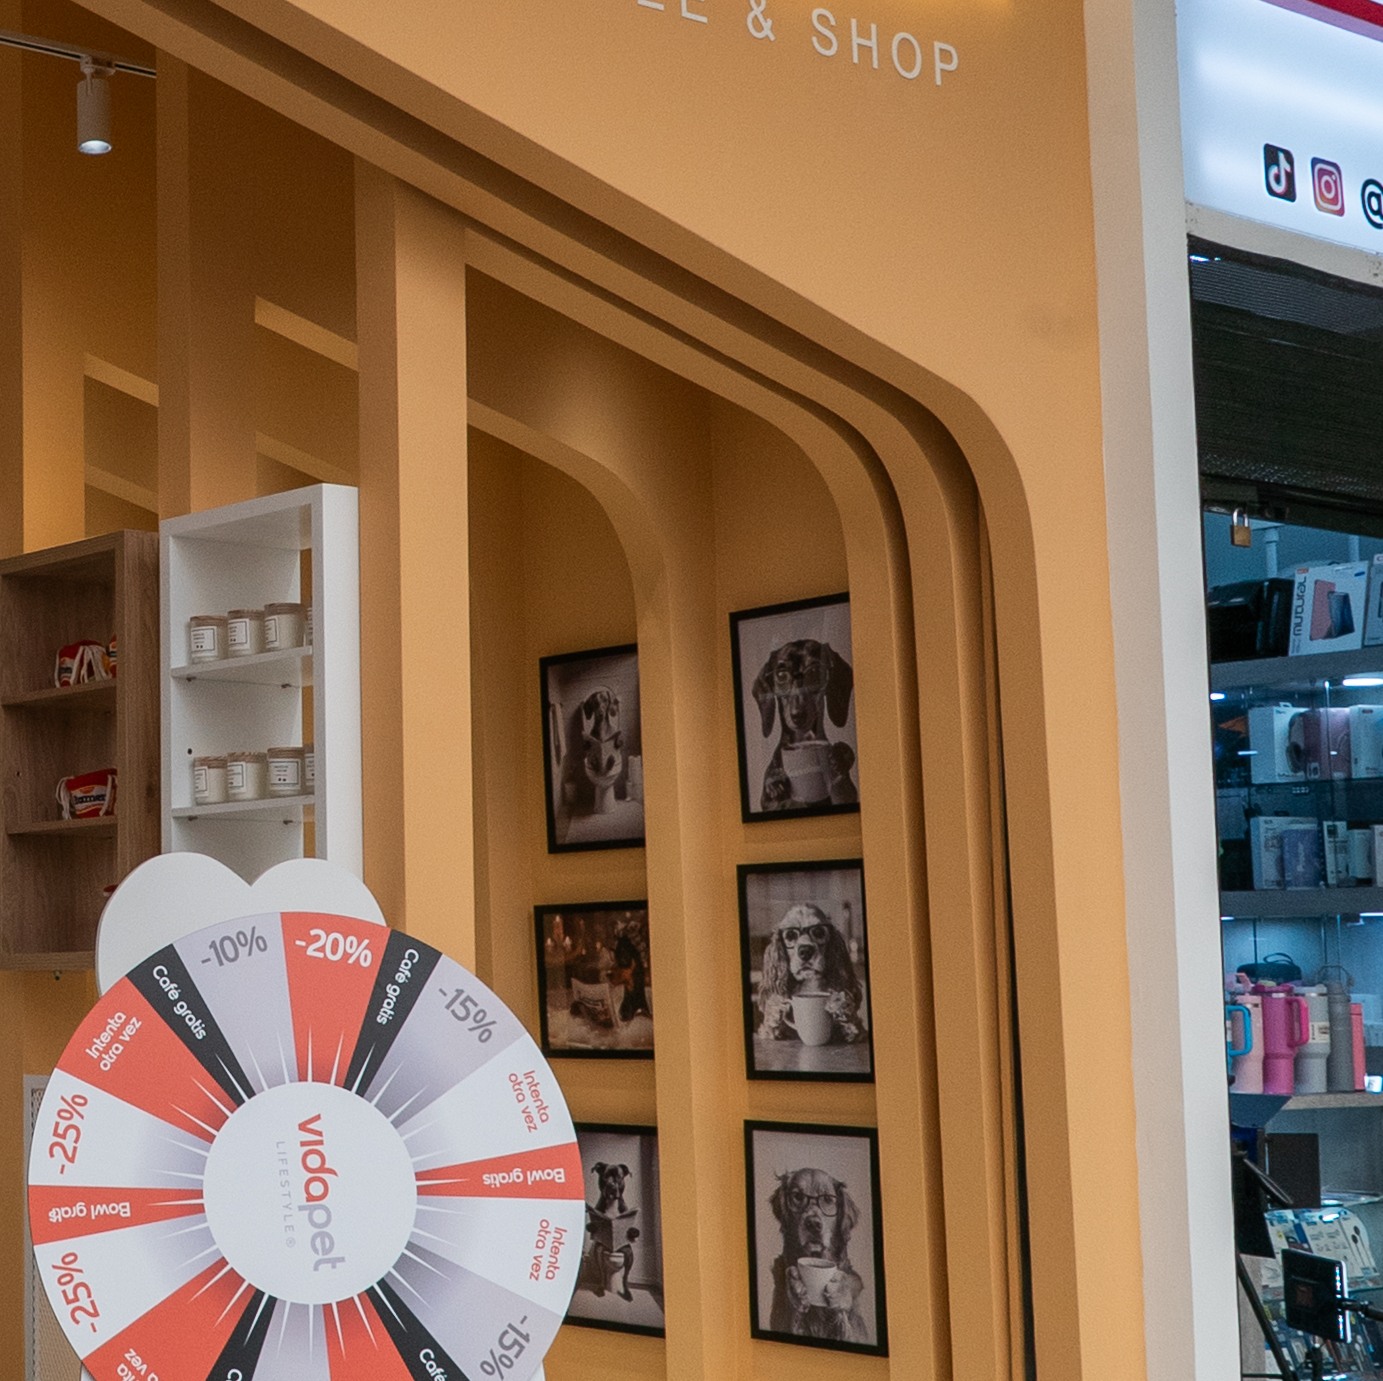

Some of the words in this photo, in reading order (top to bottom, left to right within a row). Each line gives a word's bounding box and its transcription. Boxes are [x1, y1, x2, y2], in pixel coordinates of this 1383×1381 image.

[811, 7, 958, 86] SHOP
[201, 926, 267, 966] -10%
[295, 929, 372, 967] -20%
[395, 948, 419, 983] Café
[153, 965, 181, 1000] Café
[173, 1001, 207, 1040] gratis
[376, 984, 400, 1025] gratis
[438, 988, 497, 1043] -15%
[85, 1011, 126, 1059] Intenta
[100, 1043, 124, 1071] otra
[119, 1016, 142, 1043] vez
[508, 1073, 525, 1103] otra
[521, 1106, 538, 1133] vez
[523, 1070, 549, 1123] Intenta
[49, 1094, 88, 1174] -25%
[298, 1113, 346, 1271] vidapet
[482, 1168, 524, 1188] gratis
[527, 1168, 565, 1185] Bowl
[91, 1202, 131, 1220] Bowl
[535, 1219, 551, 1249] otra
[529, 1255, 543, 1281] vez
[545, 1226, 567, 1280] Intenta
[51, 1252, 100, 1333] -25%
[124, 1348, 147, 1375] vez
[480, 1315, 530, 1381] -15%
